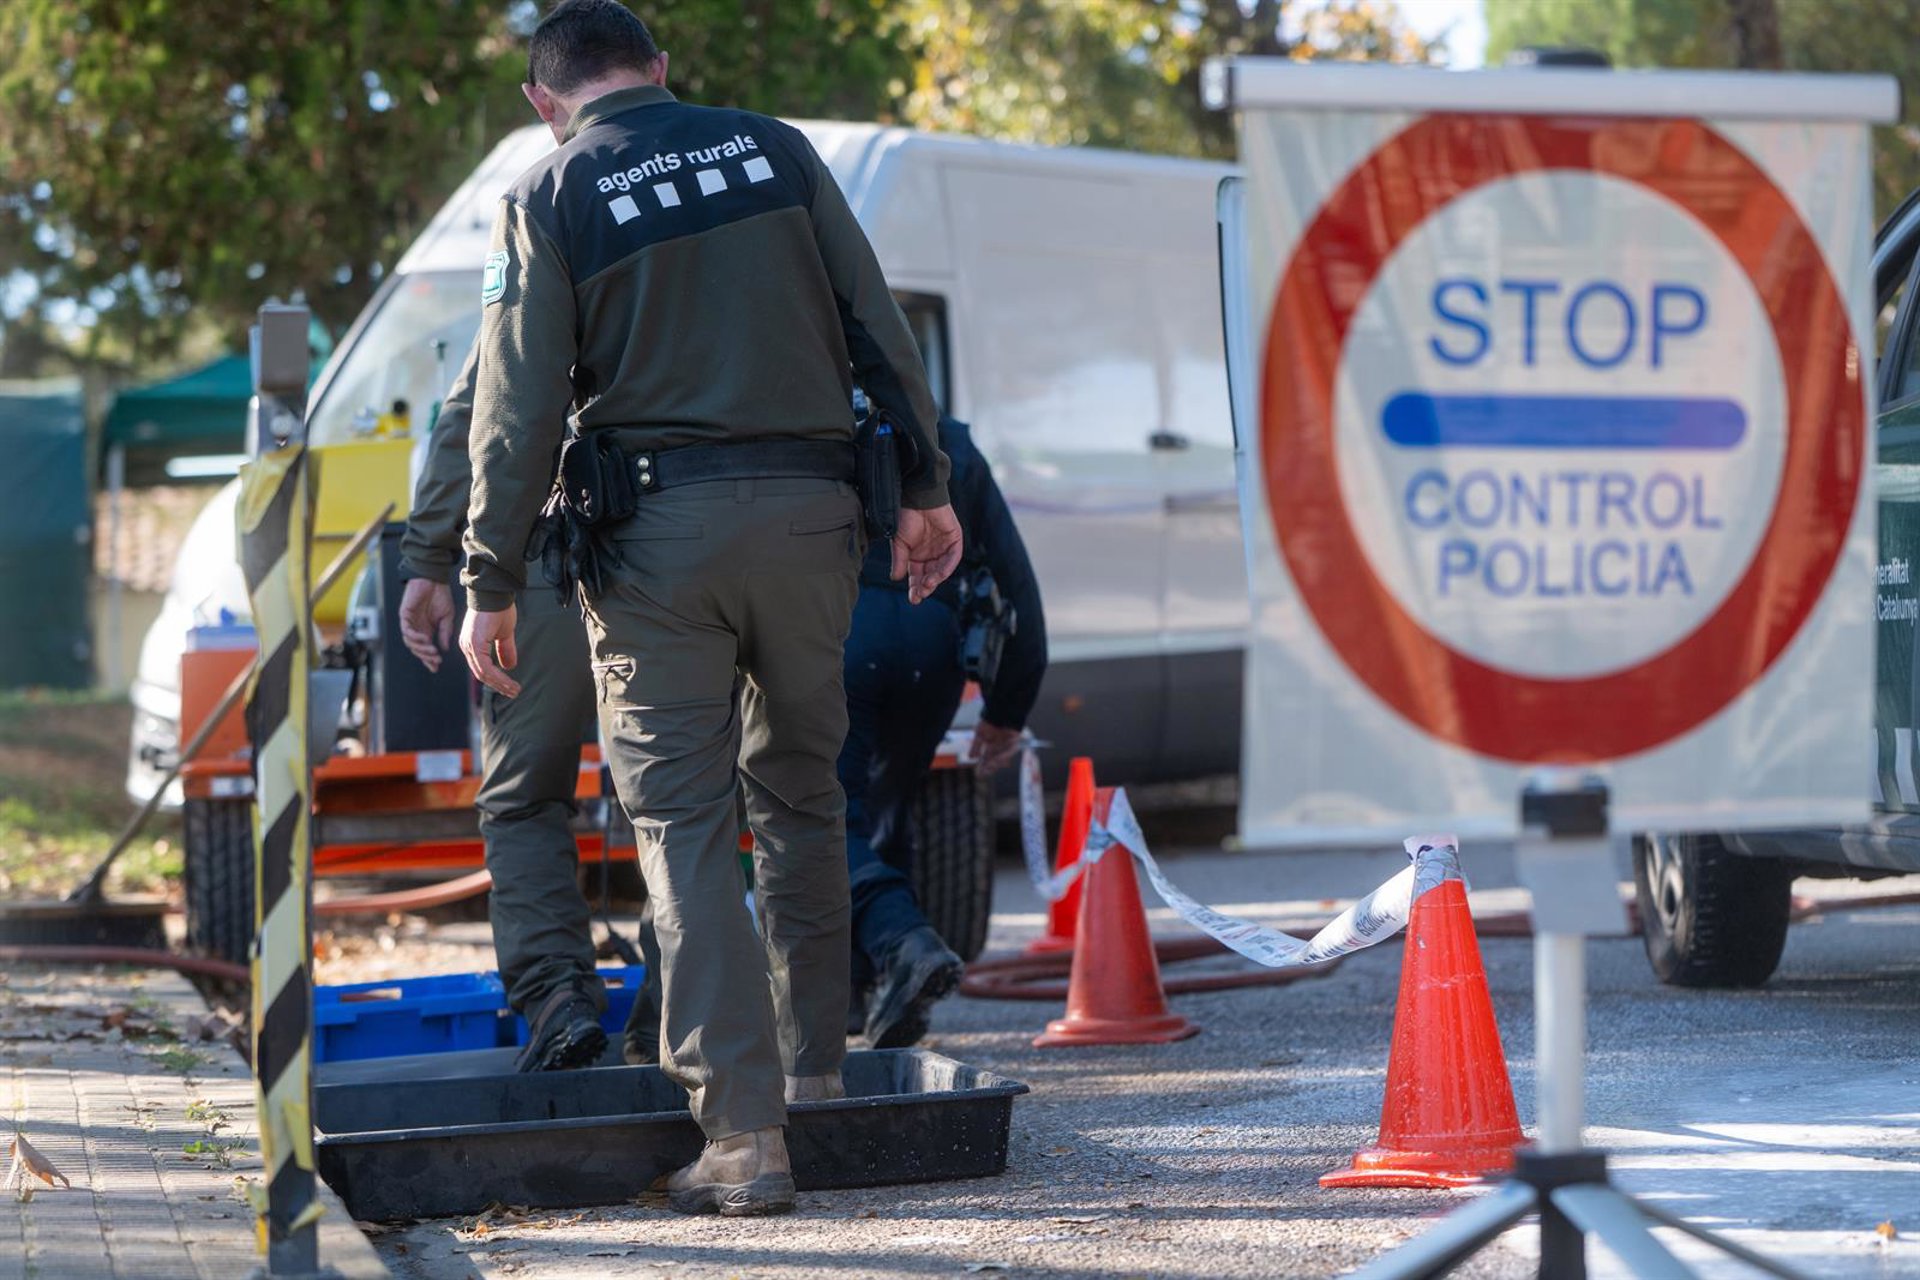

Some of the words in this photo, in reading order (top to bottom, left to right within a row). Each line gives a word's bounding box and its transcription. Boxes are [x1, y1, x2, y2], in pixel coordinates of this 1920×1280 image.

[597, 152, 682, 193] agents
[685, 134, 758, 164] rurals
[1428, 278, 1709, 370] STOP
[1405, 469, 1726, 530] CONTROL
[1437, 538, 1695, 597] POLICIA
[1877, 593, 1918, 627] Catalunya
